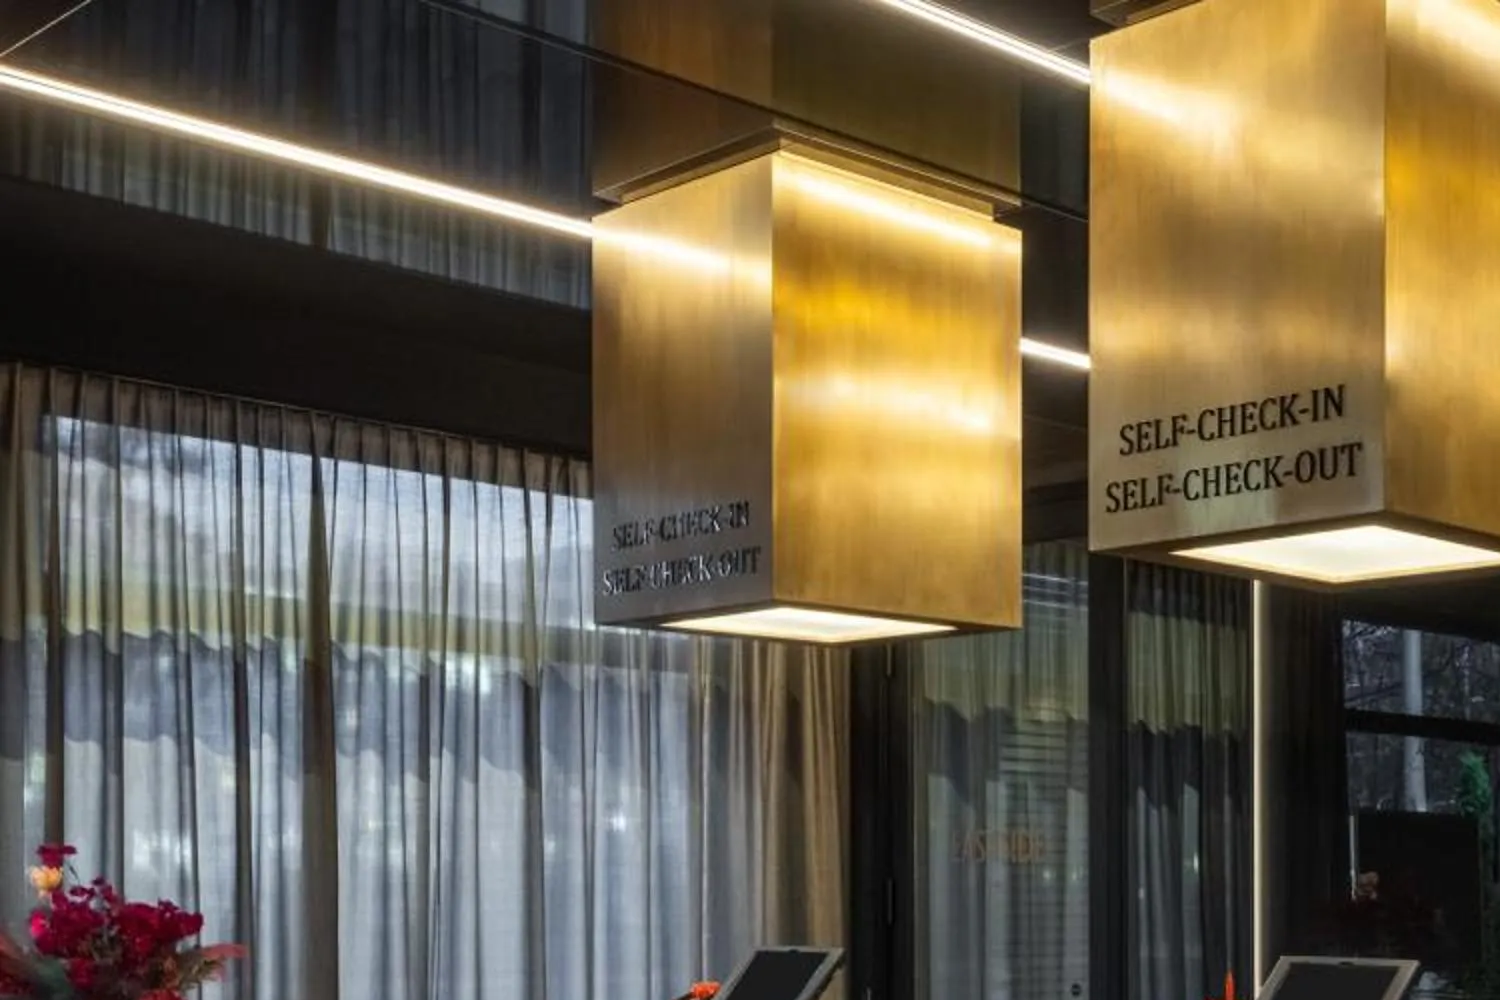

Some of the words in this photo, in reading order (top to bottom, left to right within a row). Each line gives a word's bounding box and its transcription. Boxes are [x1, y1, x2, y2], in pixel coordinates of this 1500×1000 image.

[1119, 384, 1345, 456] SELF-CHECK-IN
[1105, 442, 1363, 513] SELF-CHECK-OUT
[611, 501, 750, 550] SELF-CHECK-IN
[602, 546, 761, 596] SELF-CHECK-OUT
